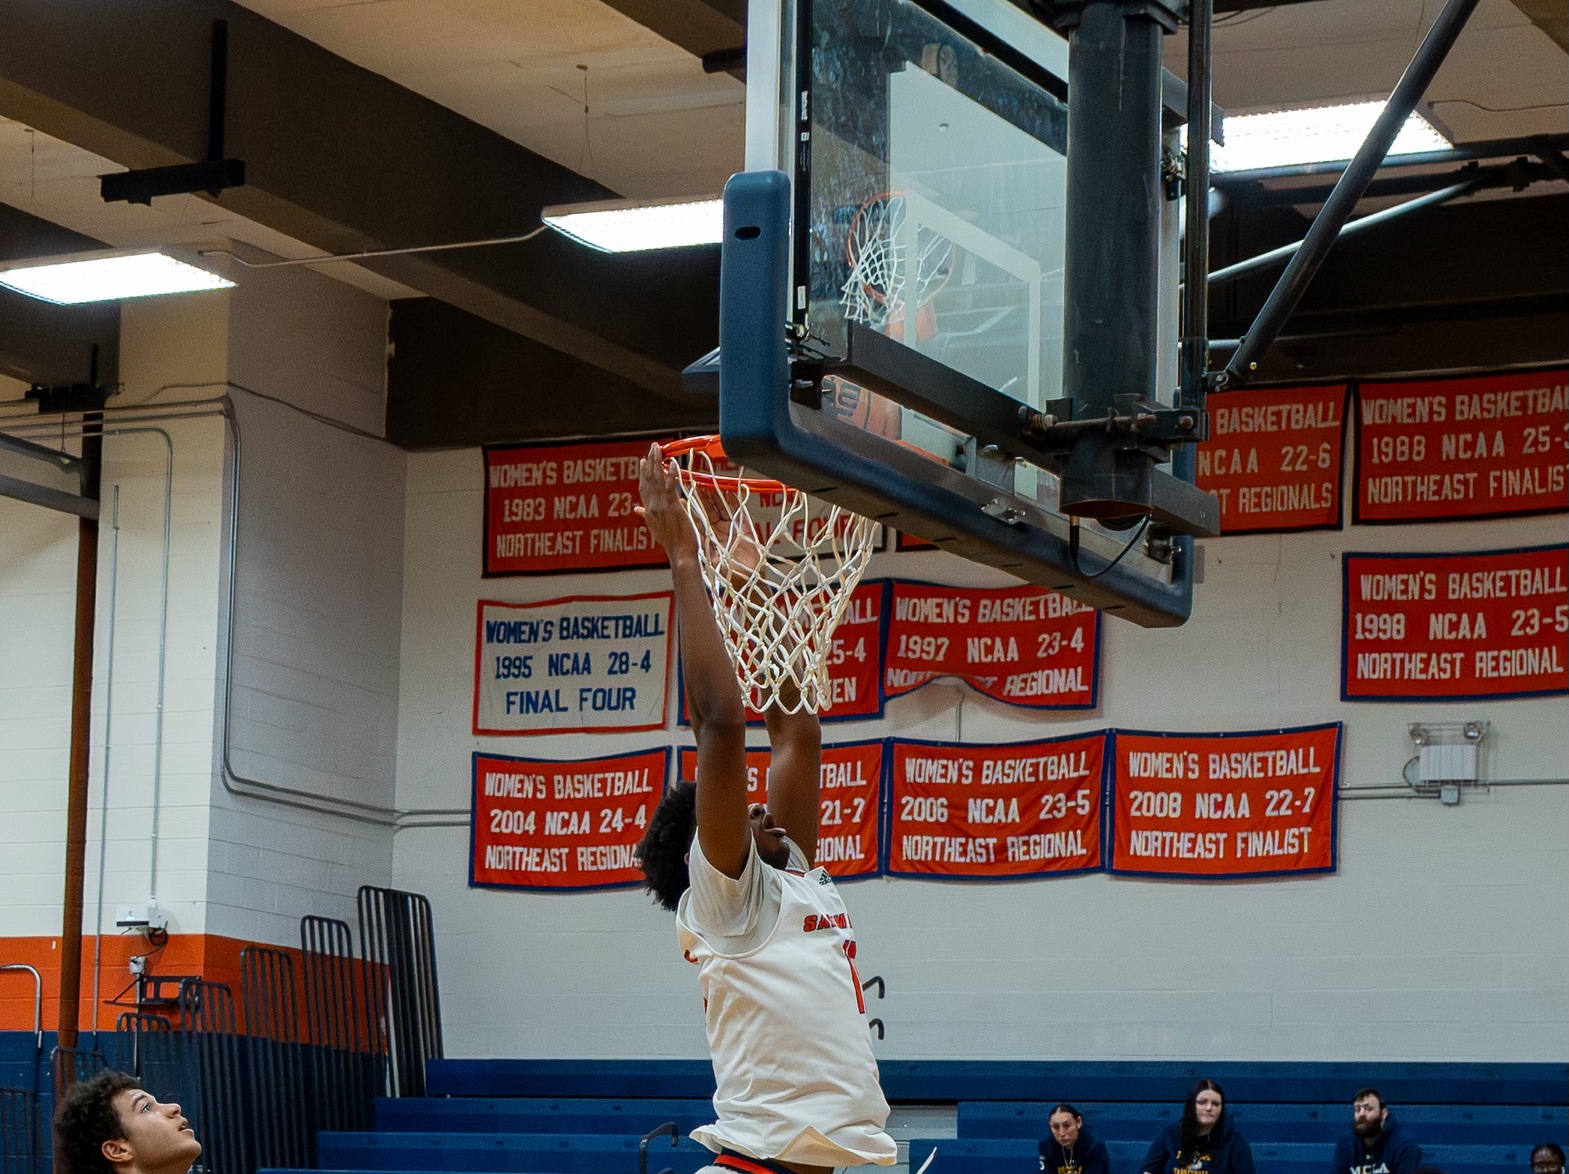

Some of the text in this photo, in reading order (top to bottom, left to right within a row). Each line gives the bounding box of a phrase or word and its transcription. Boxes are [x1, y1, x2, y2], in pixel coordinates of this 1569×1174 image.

[1216, 401, 1340, 435] BASKETBALL
[1362, 384, 1569, 426] WOMEN'S BASKETBA
[1198, 441, 1332, 477] NCAA 22-6
[1371, 435, 1426, 464] 1988
[1441, 430, 1505, 461] NCAA
[490, 456, 641, 489] WOMEN'S BASKETB
[1368, 465, 1569, 504] NORTHEAST FINALIS
[503, 498, 546, 523] 1983
[553, 494, 599, 520] NCAA
[1238, 481, 1333, 514] REGIONALS
[496, 530, 584, 559] NORTHEAST
[1360, 566, 1568, 601] WOMEN'S BASKETBALL
[895, 596, 971, 624] WOMEN'S
[1354, 604, 1569, 641] 1998 NCAA 23-5
[485, 613, 666, 645] WOMEN'S BASKETBALL
[897, 626, 1085, 664] 1997 NCAA 23-4
[494, 651, 651, 680] 1995 NCAA 28-4
[1357, 645, 1565, 681] NORTHEAST REGIONAL
[1002, 665, 1090, 697] REGIONAL
[505, 687, 637, 715] FINAL FOUR
[819, 760, 867, 789] TBALL
[905, 751, 1090, 786] WOMEN'S BASKETBALL
[1128, 746, 1321, 780] WOMEN'S BASKETBALL
[484, 767, 654, 800] WOMEN'S BASKETBALL
[820, 797, 866, 826] 21-7
[900, 788, 1091, 824] 2006 NCAA 23-5
[1128, 786, 1316, 820] 2008 NCAA 22-7
[489, 804, 647, 836] 2004 NCAA 24-4
[485, 843, 642, 873] NORTHEAST REGIONA
[815, 834, 865, 863] IONAL
[902, 829, 1088, 864] NORTHEAST REGIONAL
[1129, 826, 1313, 860] NORTHEAST FINALIST
